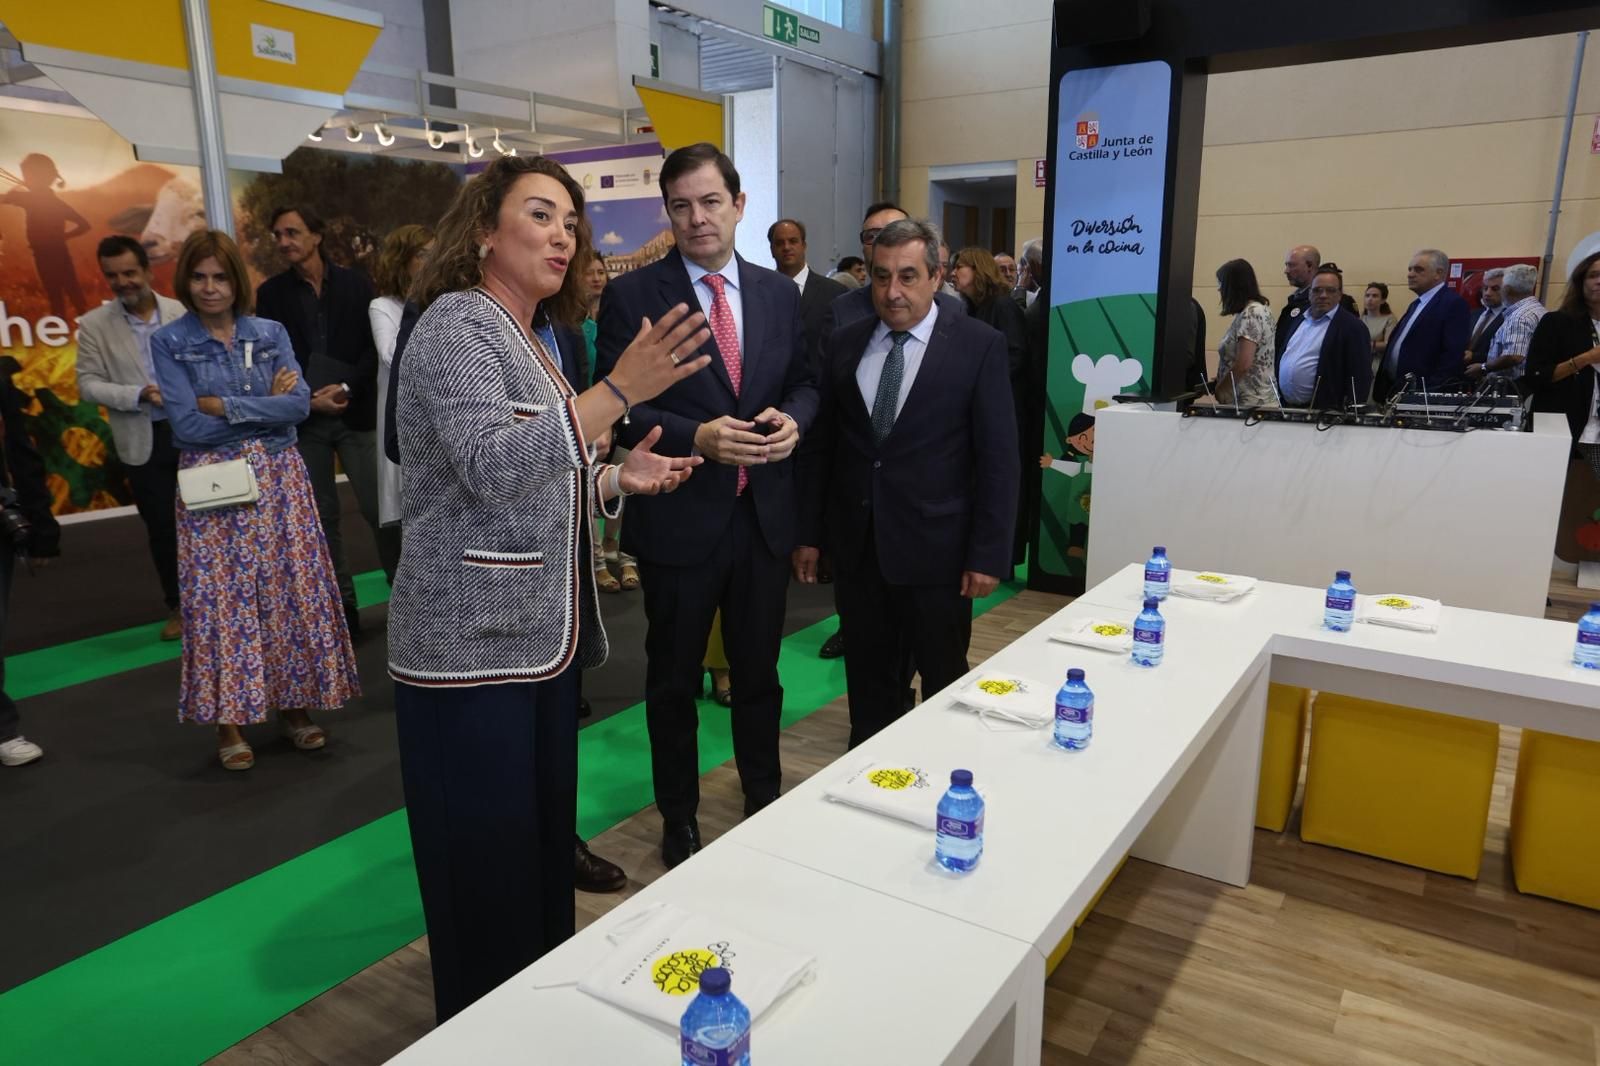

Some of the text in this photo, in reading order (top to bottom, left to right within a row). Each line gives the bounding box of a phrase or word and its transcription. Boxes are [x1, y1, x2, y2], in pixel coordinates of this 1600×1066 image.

[800, 28, 818, 41] SALIDA
[1101, 134, 1154, 148] Junta de
[1068, 145, 1153, 161] Castilla y León
[1071, 215, 1143, 237] Diversión
[1067, 240, 1144, 256] en la cocina
